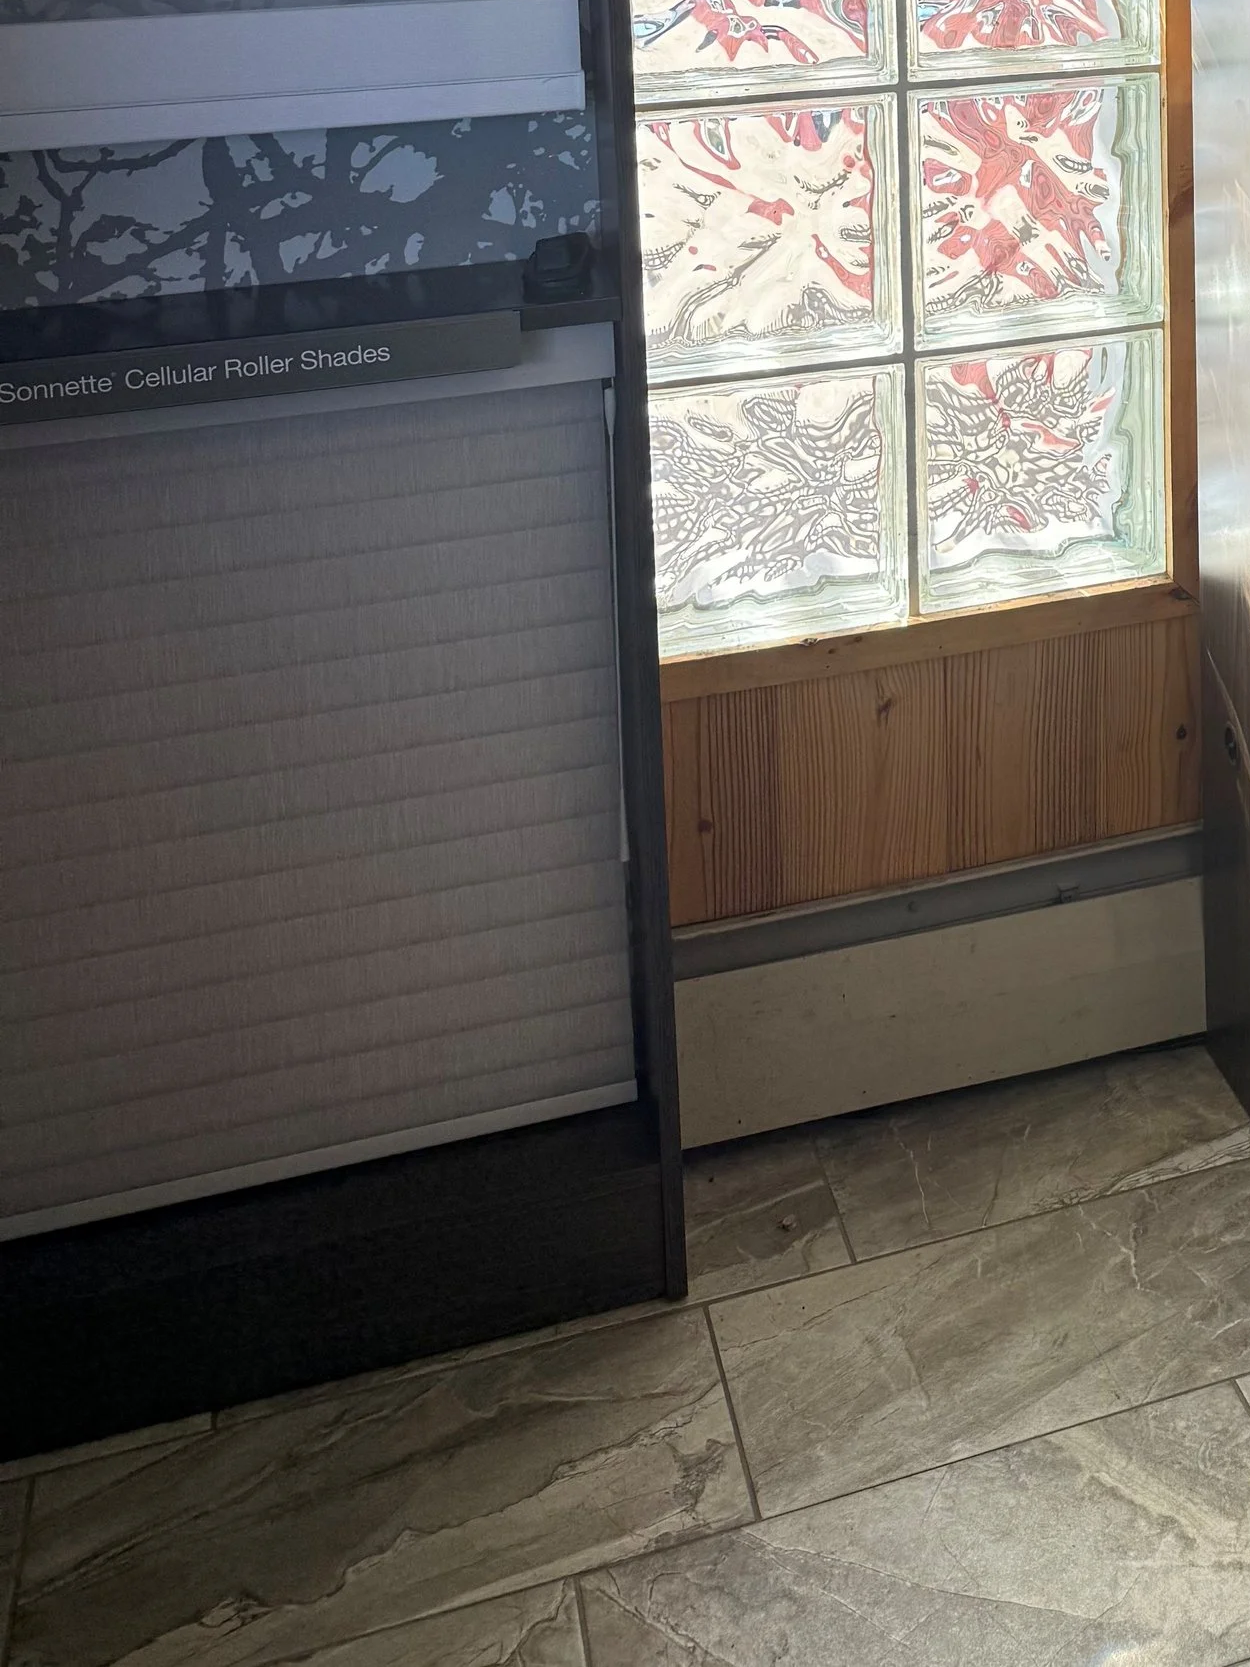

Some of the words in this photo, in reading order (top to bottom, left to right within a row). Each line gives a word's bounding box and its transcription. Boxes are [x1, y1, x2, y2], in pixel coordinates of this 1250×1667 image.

[125, 364, 218, 390] Cellular
[224, 355, 294, 379] Roller
[300, 345, 391, 370] Shades
